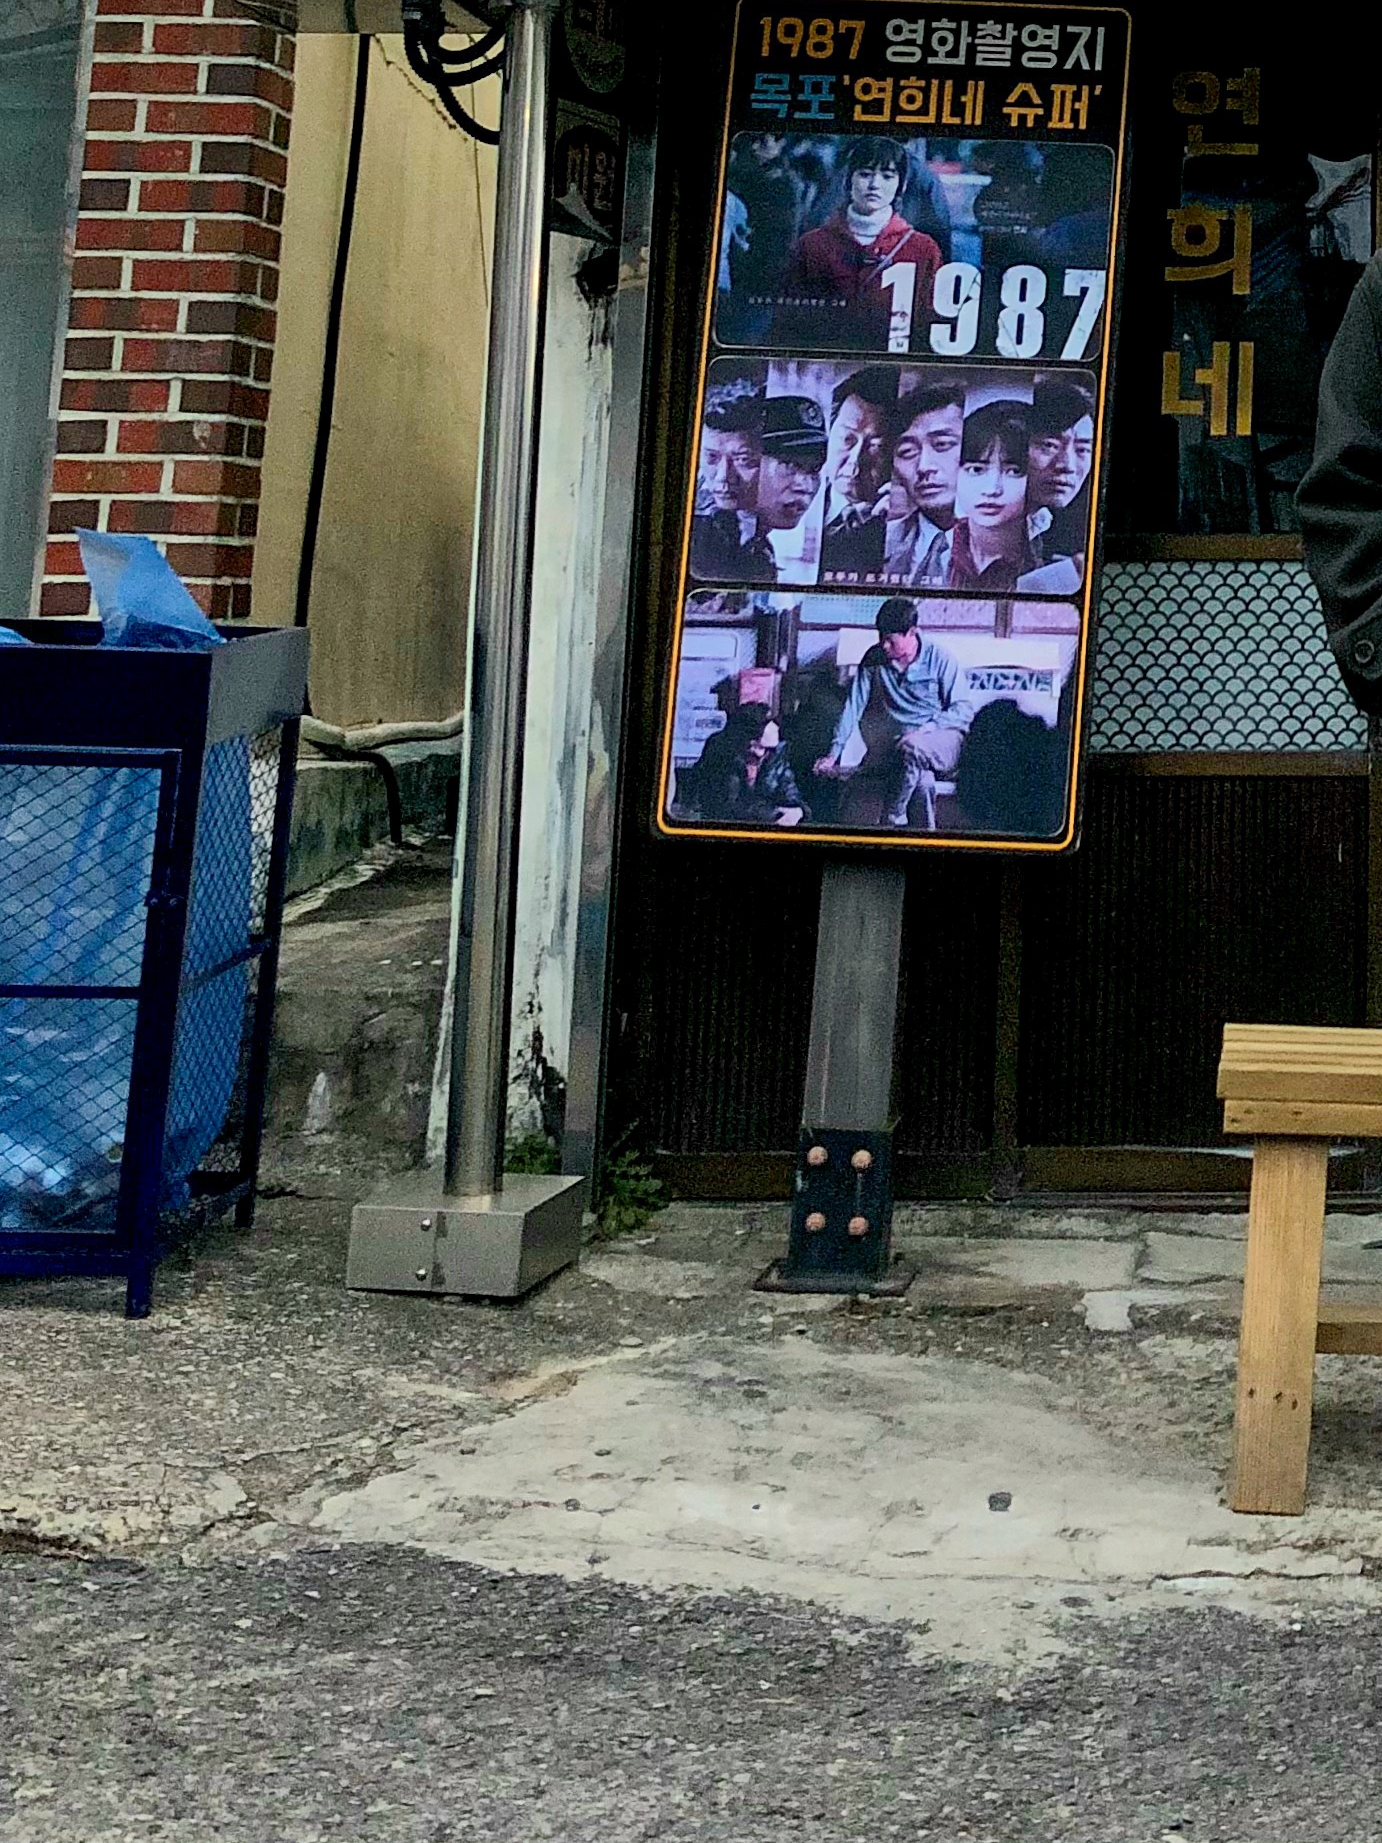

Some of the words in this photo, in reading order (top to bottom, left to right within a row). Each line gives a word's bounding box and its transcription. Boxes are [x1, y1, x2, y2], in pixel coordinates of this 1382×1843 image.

[760, 16, 866, 60] 1987
[885, 17, 1106, 71] 영화촬영지
[881, 260, 1107, 360] 1987
